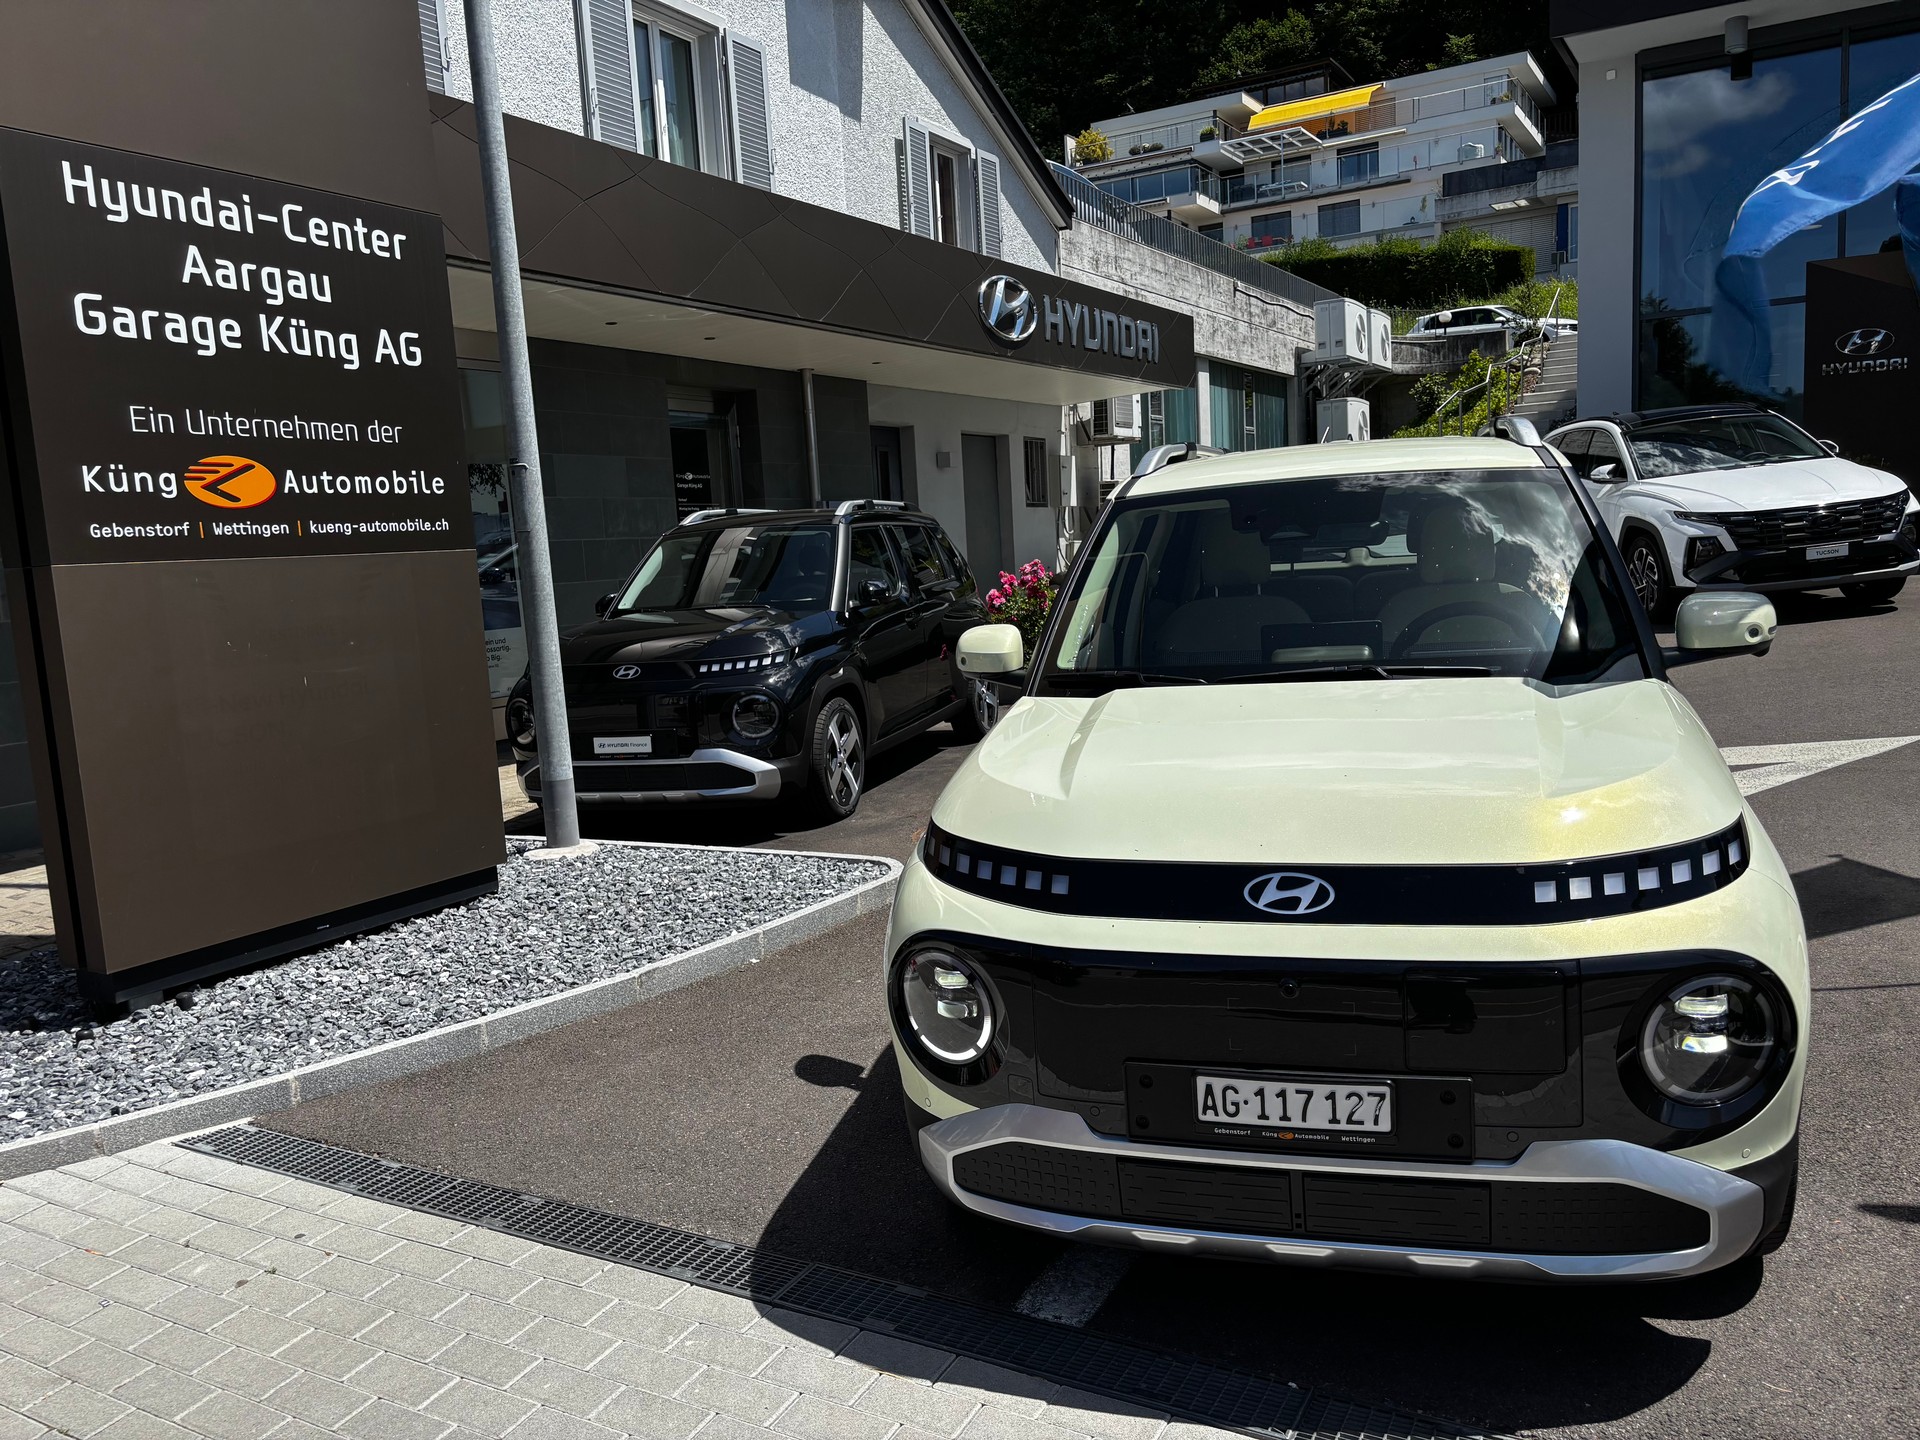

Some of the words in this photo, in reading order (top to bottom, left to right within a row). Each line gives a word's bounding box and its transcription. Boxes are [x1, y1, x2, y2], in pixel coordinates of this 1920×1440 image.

[61, 160, 407, 260] Hyundai-Center
[181, 244, 333, 305] Aargau
[73, 292, 243, 357] Garage
[258, 313, 360, 370] Küng
[374, 328, 422, 368] AG
[1042, 294, 1160, 365] HYUNDAI
[1821, 357, 1908, 376] HYUNDAI
[129, 405, 175, 434] Ein
[185, 408, 359, 442] Unternehmen
[367, 419, 404, 443] der
[81, 465, 178, 499] Küng
[283, 469, 446, 495] Automobile
[89, 521, 191, 539] Gebenstorf
[213, 521, 290, 537] Wettingen
[309, 518, 450, 536] kueng-automobile.ch
[1815, 548, 1840, 556] TUCSON
[486, 644, 511, 653] ossartig.
[1214, 1127, 1251, 1136] Gebenstorf
[1262, 1130, 1278, 1138] Küng
[1294, 1133, 1330, 1141] Automobile
[1341, 1135, 1376, 1144] Wettingen
